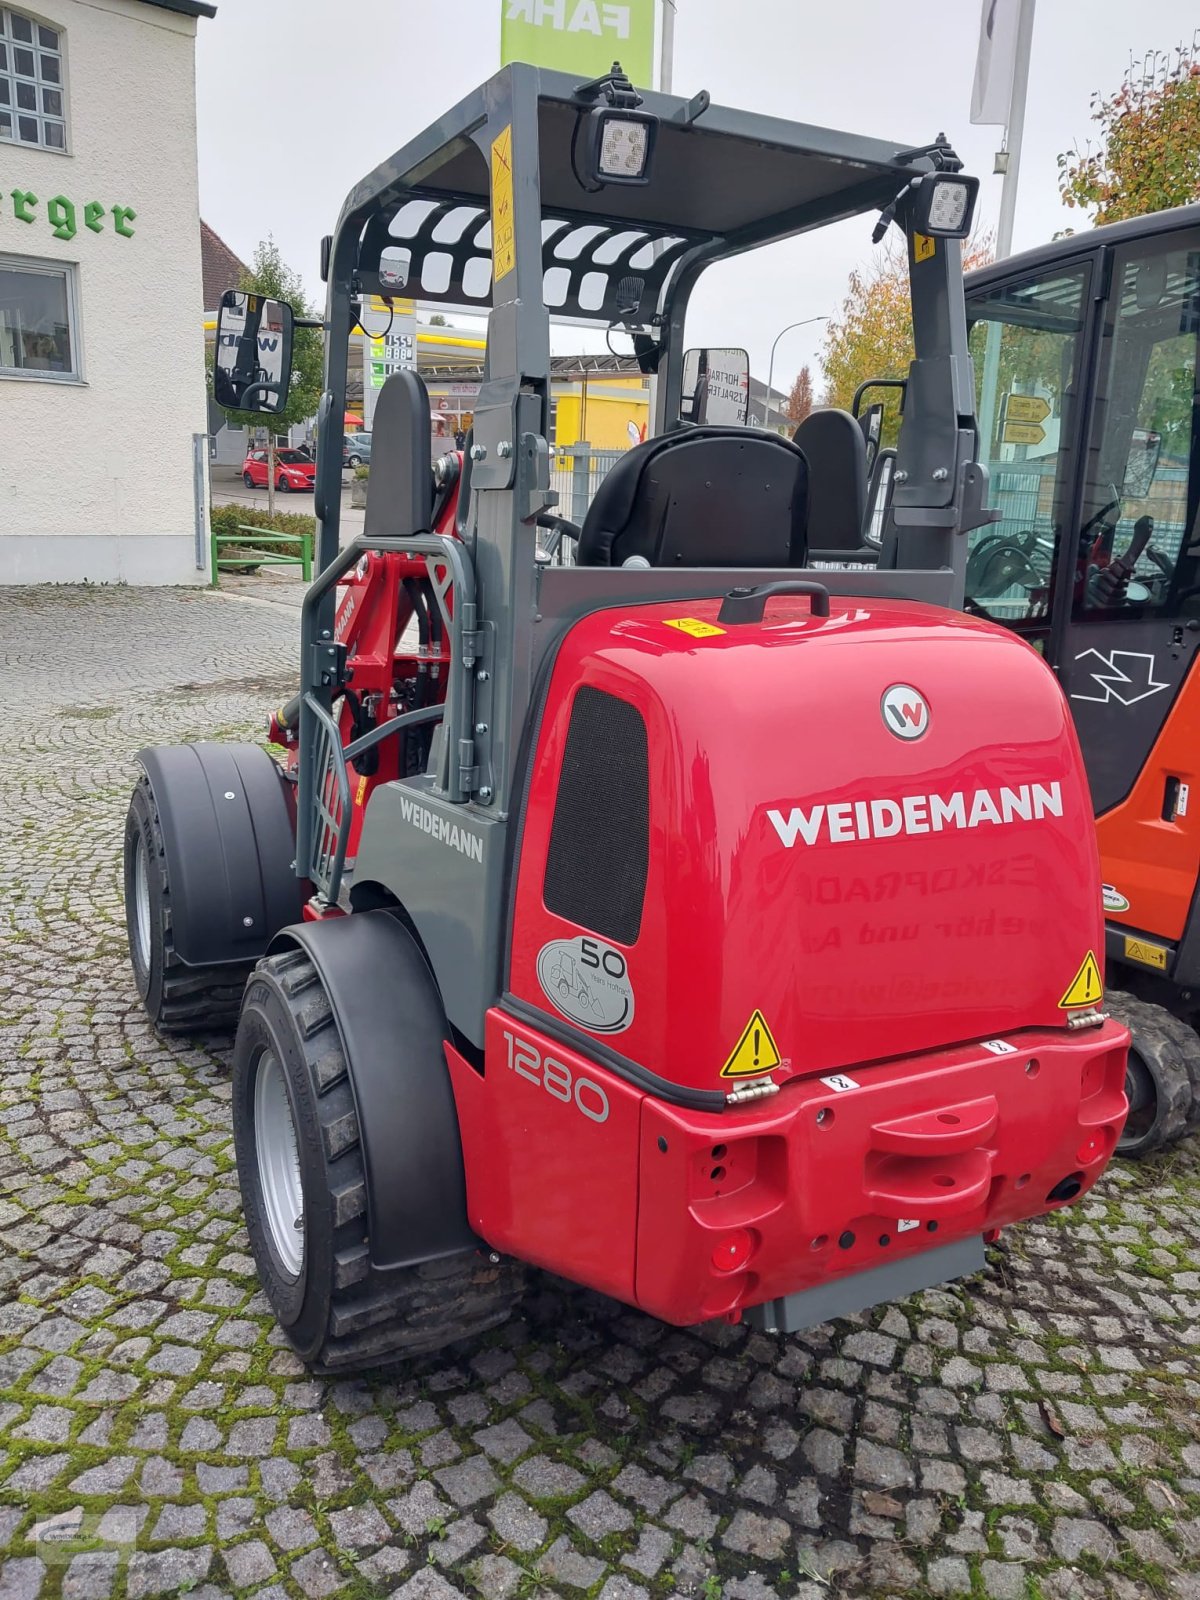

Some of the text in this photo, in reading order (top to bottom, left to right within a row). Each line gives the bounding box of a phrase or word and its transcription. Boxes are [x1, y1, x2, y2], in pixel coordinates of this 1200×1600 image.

[0, 188, 138, 241] rger
[400, 796, 483, 863] WEIDEMANN
[766, 781, 1064, 848] WEIDEMANN
[581, 938, 626, 979] 50
[503, 1030, 609, 1123] 1280
